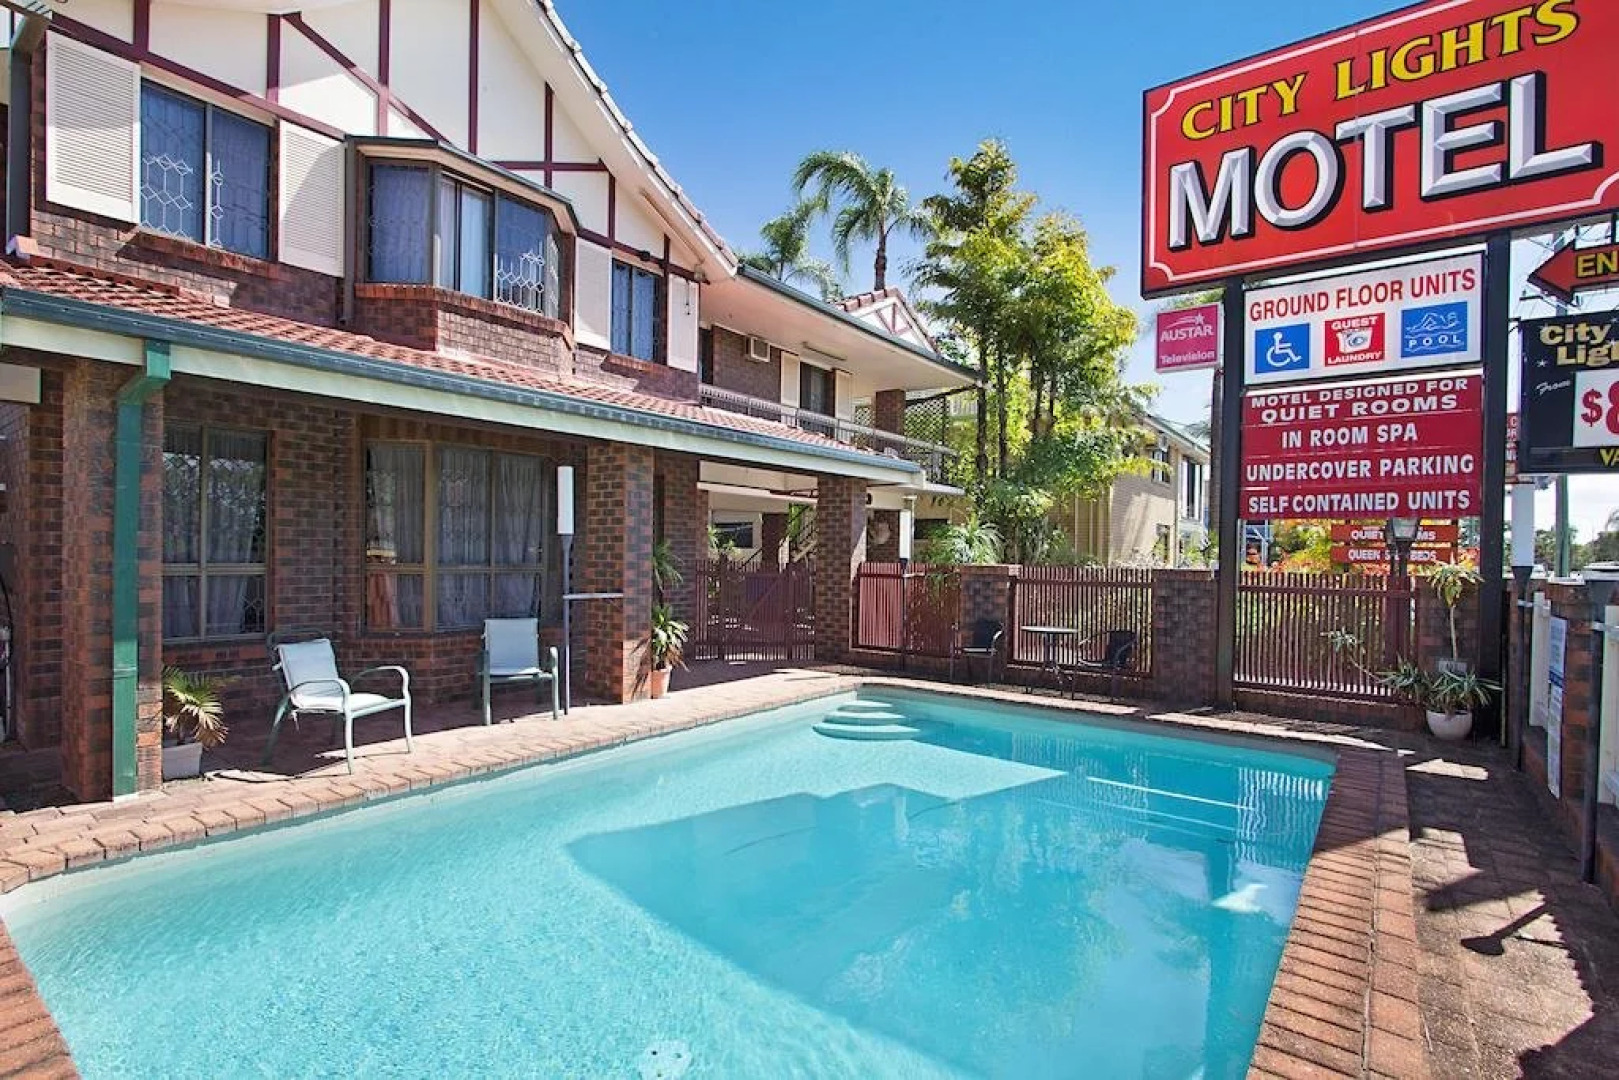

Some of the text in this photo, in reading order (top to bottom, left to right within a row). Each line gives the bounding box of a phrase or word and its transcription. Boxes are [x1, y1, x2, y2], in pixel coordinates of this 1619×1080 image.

[1181, 0, 1581, 141] CITY LIGHTS
[1168, 70, 1600, 251] MOTEL
[1249, 268, 1476, 322] GROUND FLOOR UNITS
[1160, 324, 1215, 344] AUSTAR
[1331, 315, 1379, 331] GUEST
[1540, 322, 1612, 346] City
[1160, 350, 1216, 366] Television
[1327, 350, 1383, 365] LAUNDRY
[1251, 378, 1468, 409] MOTEL DESIGNED FOR
[1536, 380, 1571, 396] From
[1261, 394, 1458, 424] QUIET ROOMS
[1281, 423, 1418, 449] IN ROOM SPA
[1246, 454, 1474, 482] UNDERCOVER PARKING
[1248, 489, 1471, 513] SELF CONTAINED UNITS
